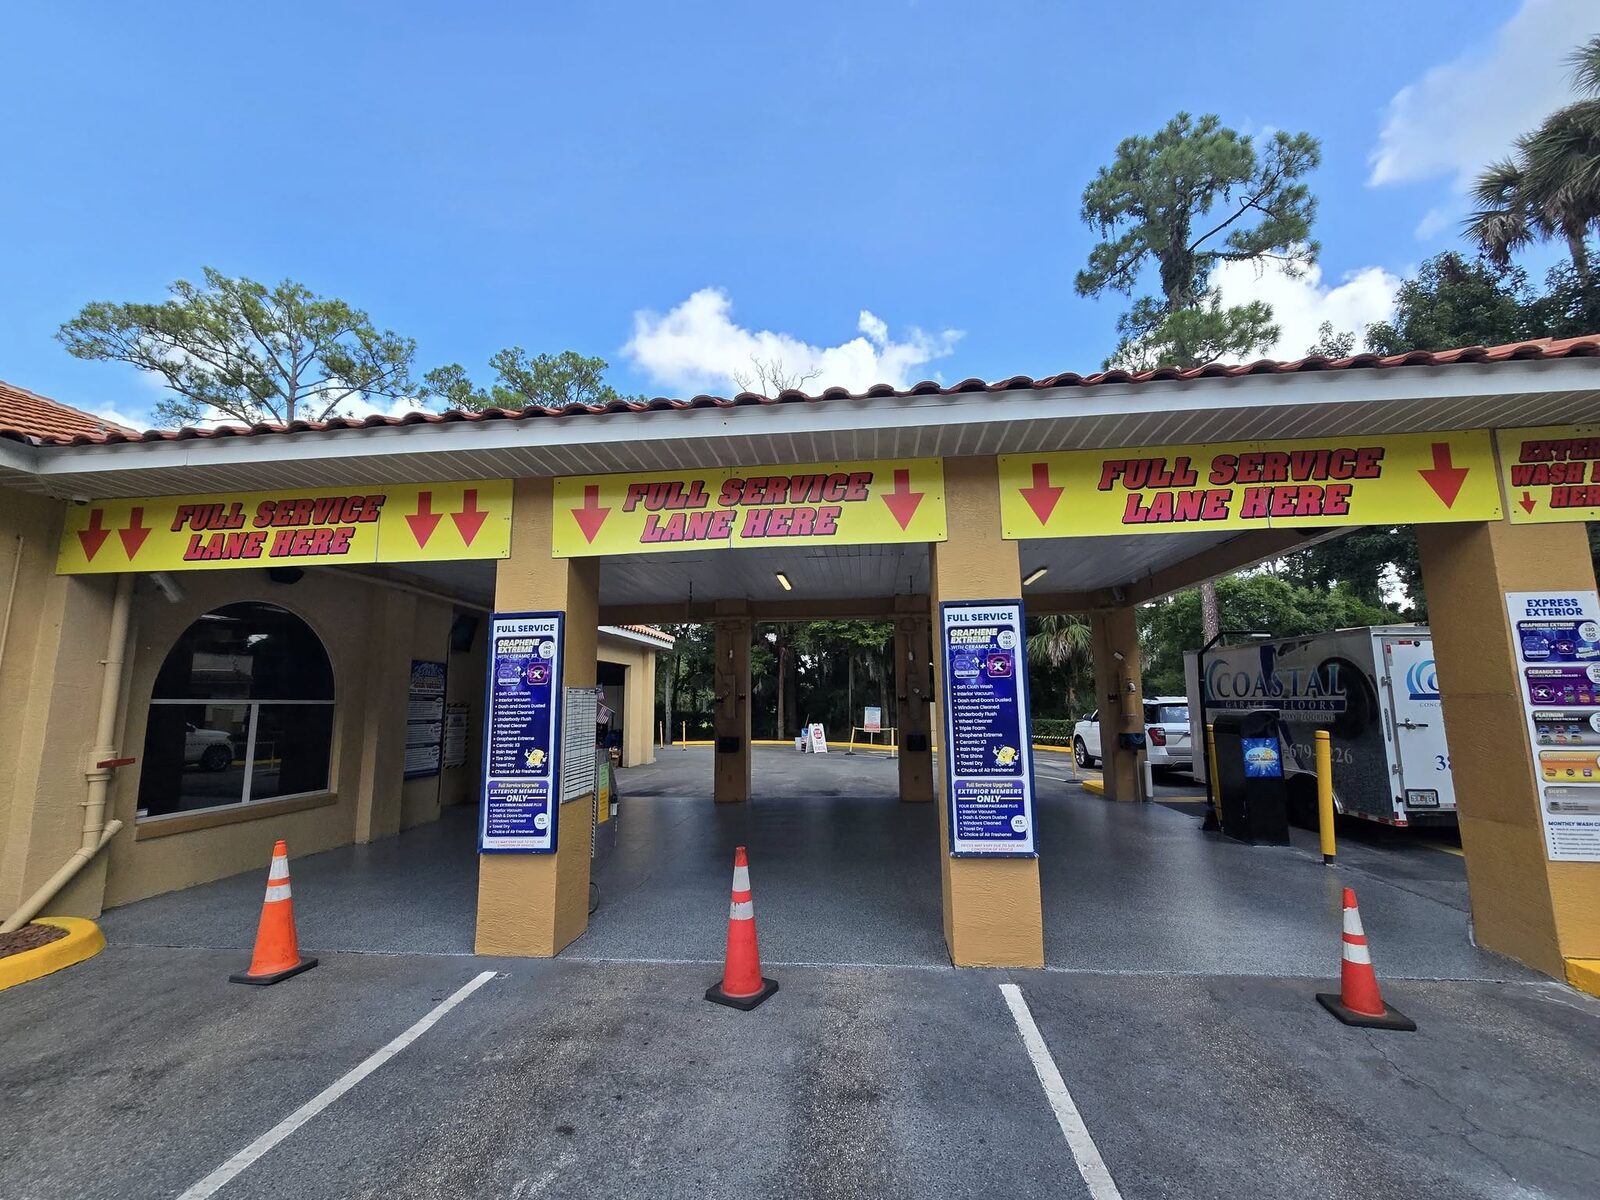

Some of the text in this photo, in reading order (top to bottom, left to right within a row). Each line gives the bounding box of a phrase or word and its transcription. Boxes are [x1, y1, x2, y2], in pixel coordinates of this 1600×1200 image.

[1098, 448, 1385, 490] FULL SERVICE
[1511, 462, 1586, 487] WASH
[623, 472, 872, 512] FULL SERVICE
[1122, 484, 1352, 524] LANE HERE
[171, 495, 386, 531] FULL SERVICE
[640, 506, 842, 542] LANE HERE
[183, 527, 355, 560] LANE HERE
[1526, 608, 1583, 616] EXTERIOR
[1527, 599, 1578, 607] EXPRESS
[950, 628, 998, 636] GRAPHENE
[951, 636, 991, 644] EXTREME
[1216, 664, 1347, 698] COASTAL
[1283, 701, 1335, 709] FLOORS
